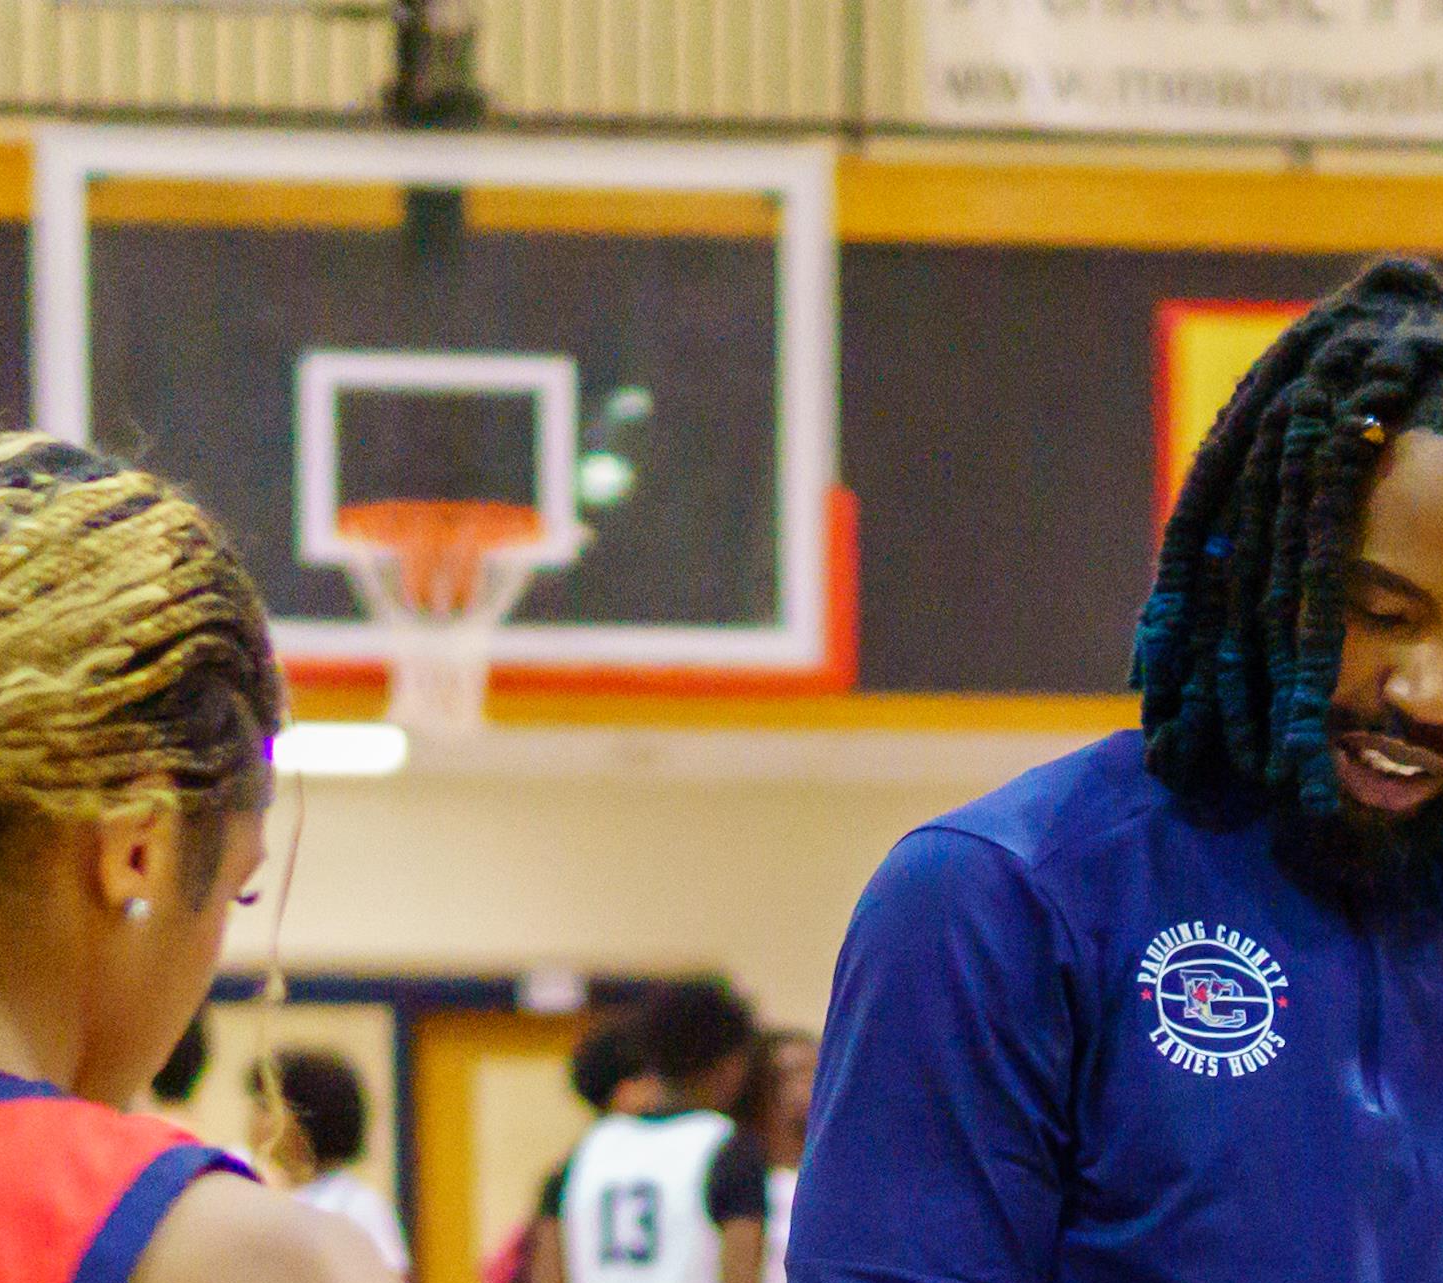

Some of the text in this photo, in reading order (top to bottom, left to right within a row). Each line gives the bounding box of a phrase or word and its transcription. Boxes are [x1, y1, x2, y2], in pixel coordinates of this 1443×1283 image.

[1137, 920, 1289, 988] PAULDING COUNTY
[1149, 1026, 1286, 1077] LADIES HOOPS
[599, 1181, 658, 1266] 13
